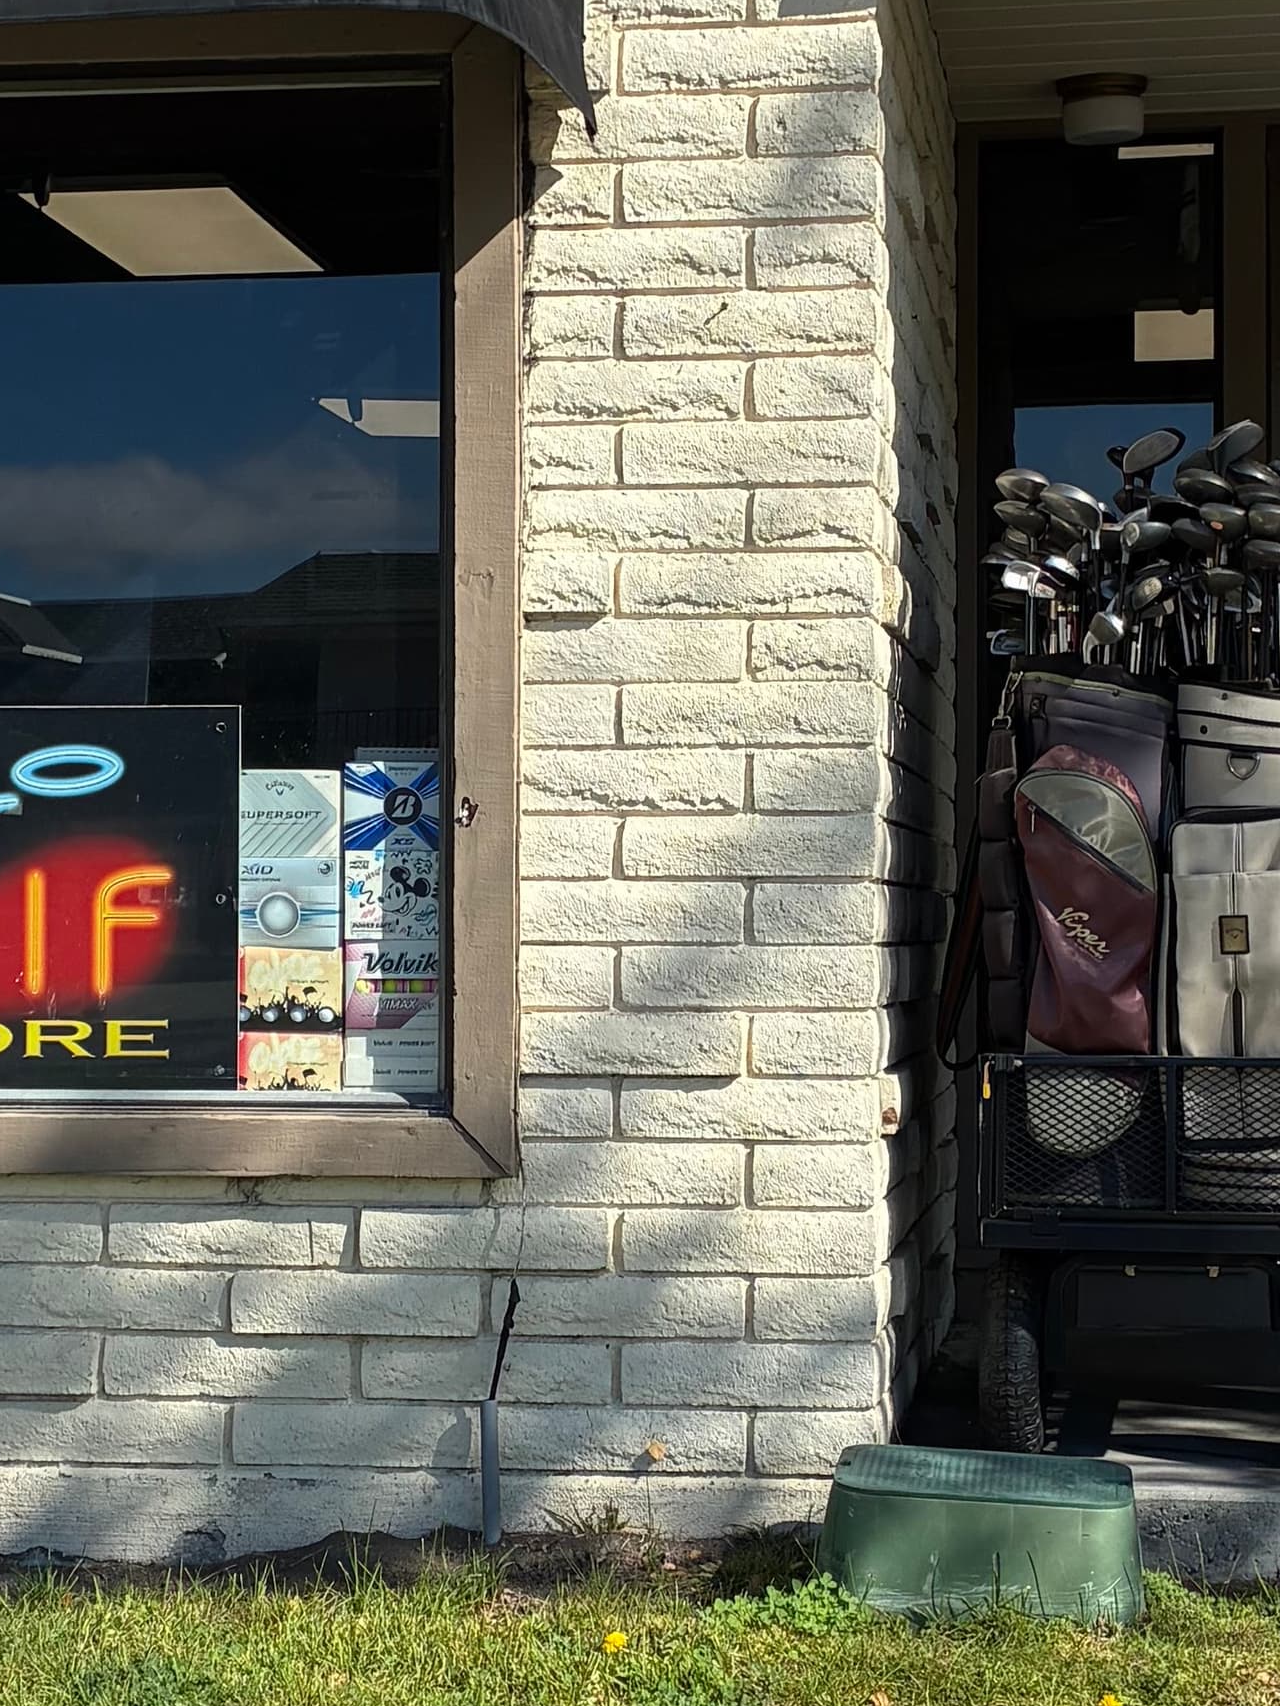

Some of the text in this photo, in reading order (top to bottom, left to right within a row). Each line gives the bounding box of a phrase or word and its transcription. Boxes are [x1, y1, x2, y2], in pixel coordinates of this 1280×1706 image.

[240, 810, 322, 820] SUPERSOFT
[391, 837, 416, 846] XS
[1056, 907, 1110, 953] Viper
[362, 951, 439, 974] Volvik
